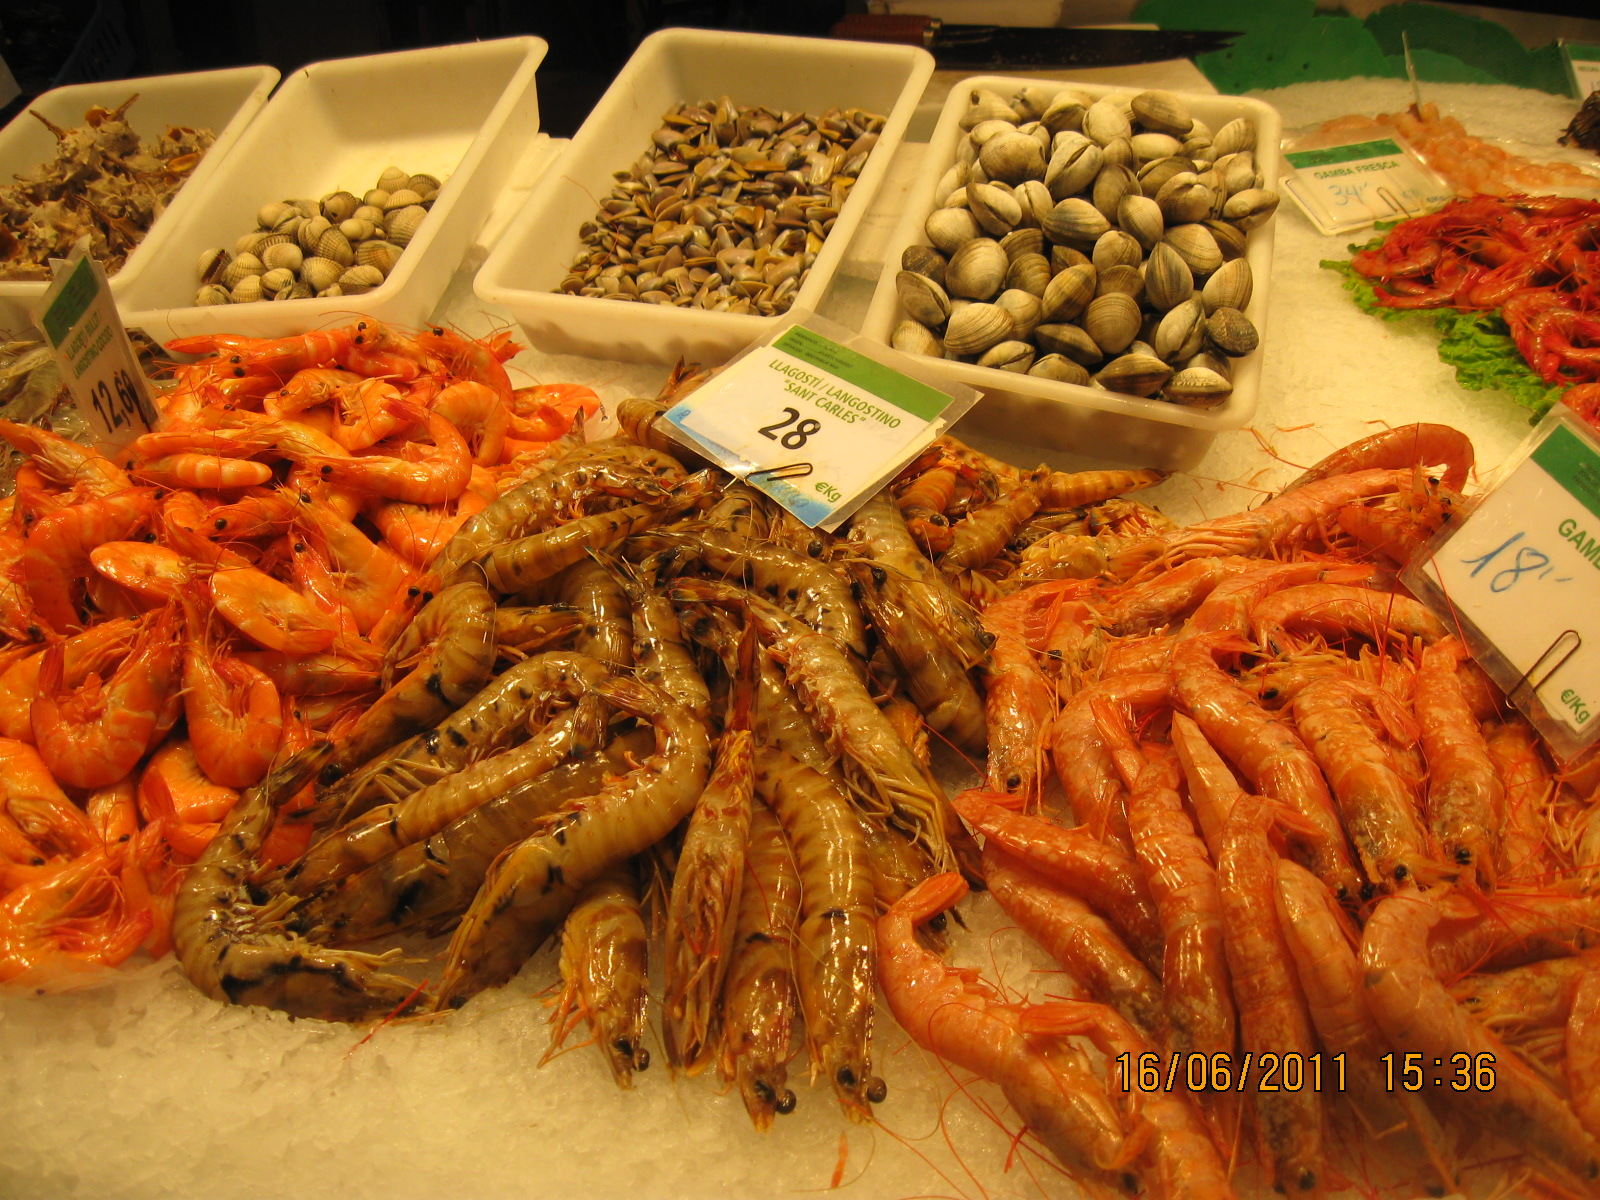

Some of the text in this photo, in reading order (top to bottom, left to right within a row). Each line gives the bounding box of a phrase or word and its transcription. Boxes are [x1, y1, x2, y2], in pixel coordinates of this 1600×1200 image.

[1314, 168, 1354, 179] GAMBA
[768, 358, 821, 389] LLAGOSTÍ
[826, 383, 902, 430] LANGOSTINO
[758, 406, 821, 450] 28
[814, 480, 843, 505] €Kg
[1559, 687, 1592, 724] €/Kg
